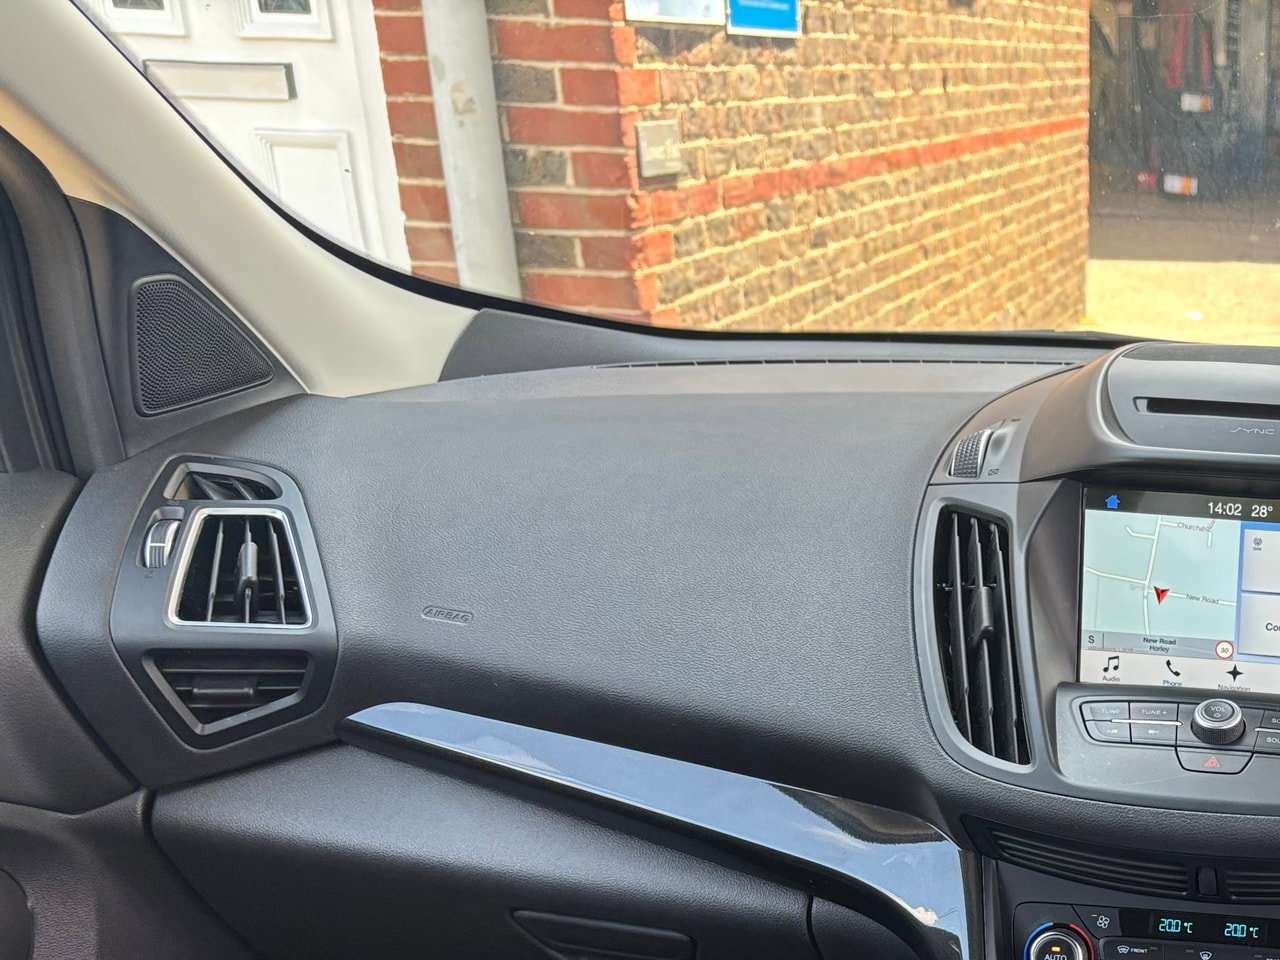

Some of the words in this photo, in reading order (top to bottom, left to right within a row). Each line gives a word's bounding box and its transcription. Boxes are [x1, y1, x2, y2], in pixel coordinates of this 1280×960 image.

[1207, 502, 1242, 516] 14:02
[1186, 593, 1199, 602] New
[1202, 595, 1219, 605] Road
[424, 608, 470, 622] AIRBAG
[1088, 635, 1095, 644] S
[1149, 645, 1170, 653] Horley
[1210, 705, 1226, 713] VOL
